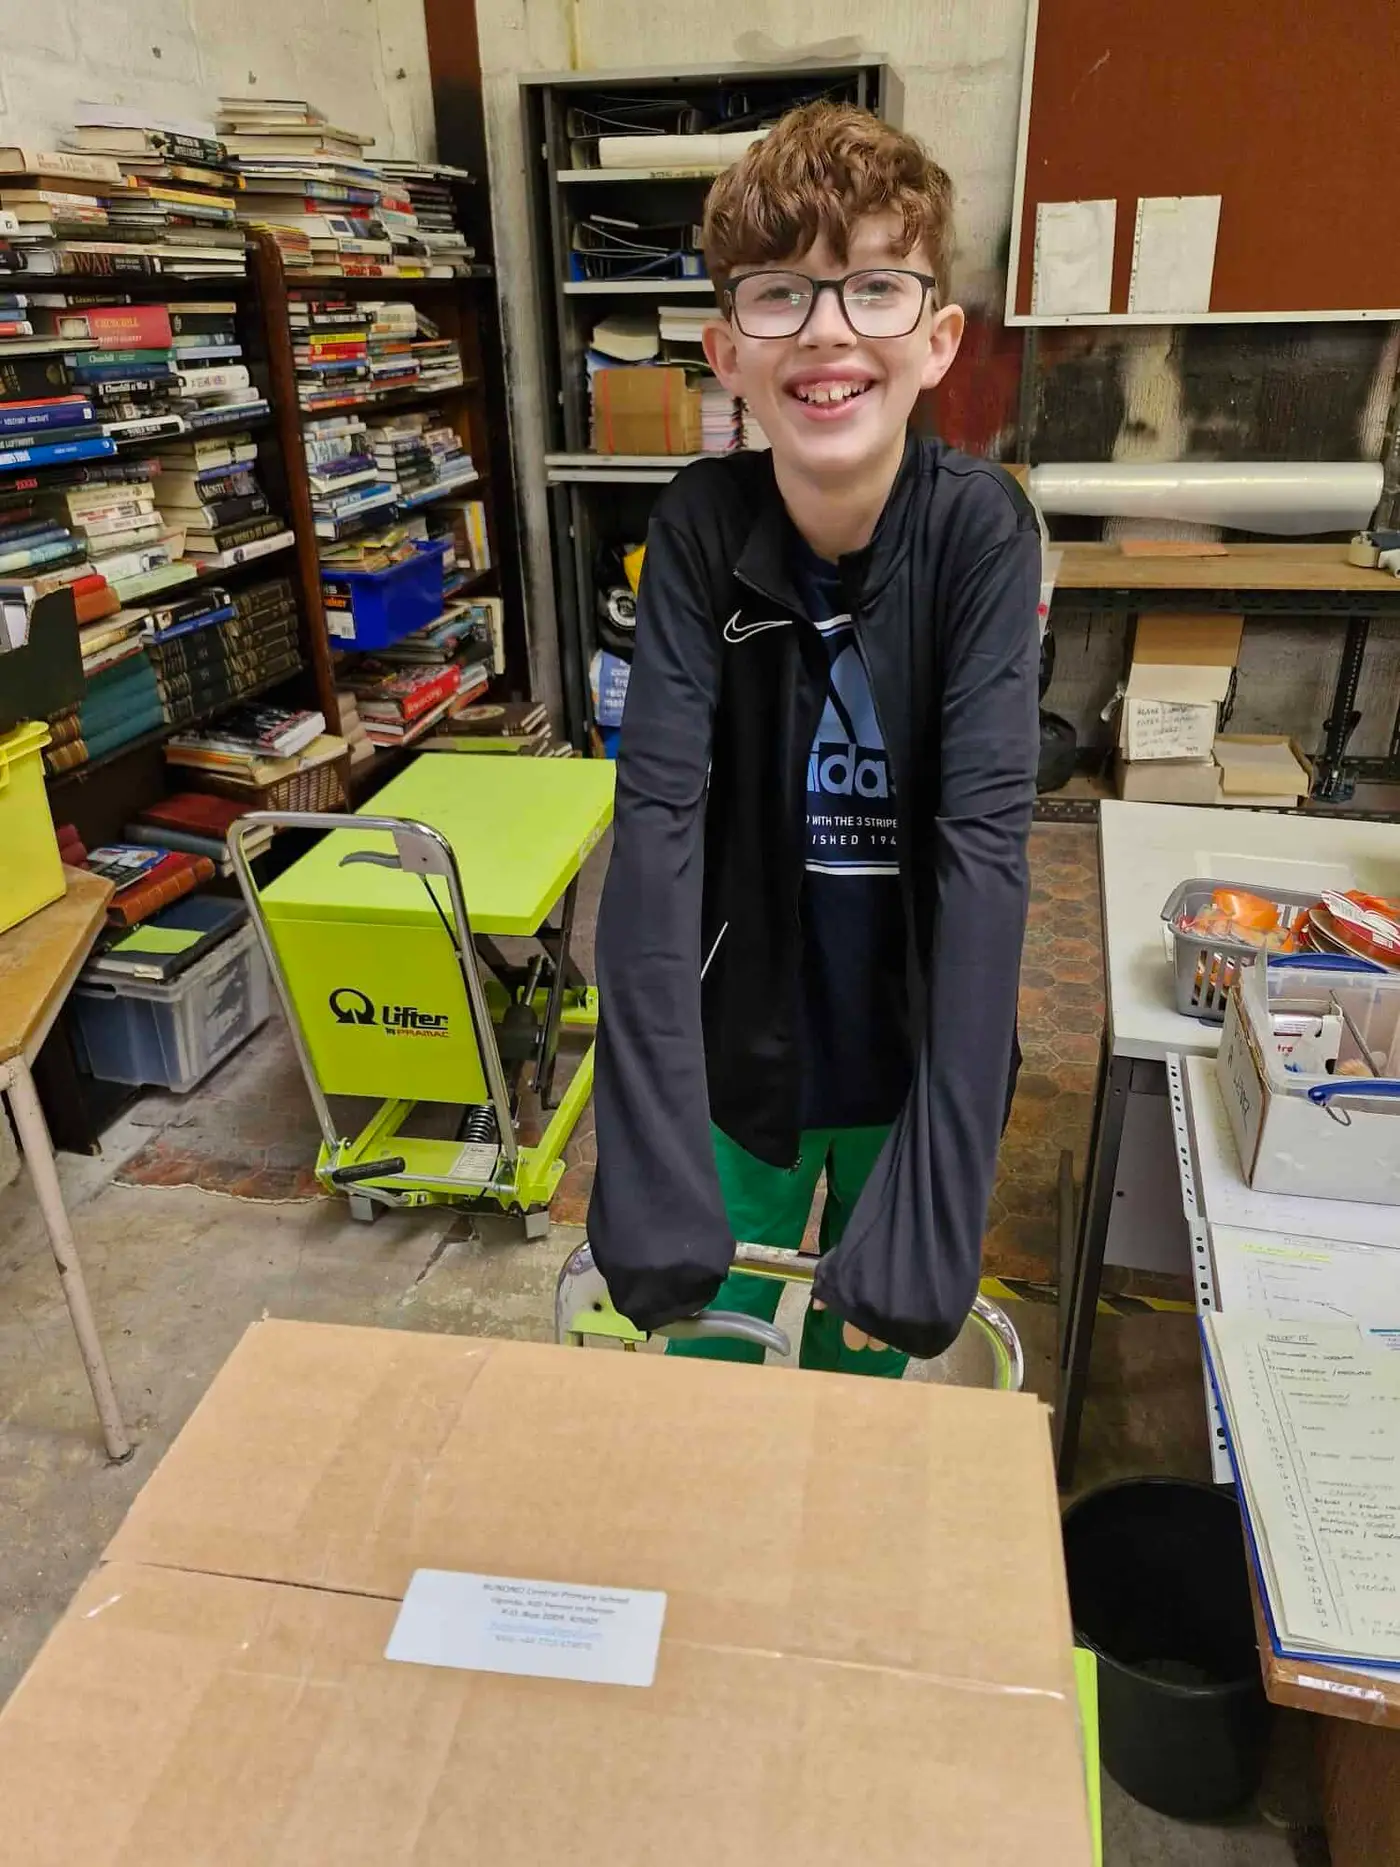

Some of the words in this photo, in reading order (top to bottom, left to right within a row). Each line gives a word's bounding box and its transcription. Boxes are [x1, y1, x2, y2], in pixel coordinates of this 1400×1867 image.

[73, 252, 114, 276] WAR
[812, 815, 832, 826] WITH
[834, 816, 854, 827] THE
[856, 816, 863, 826] 3
[382, 1005, 449, 1030] Lifter
